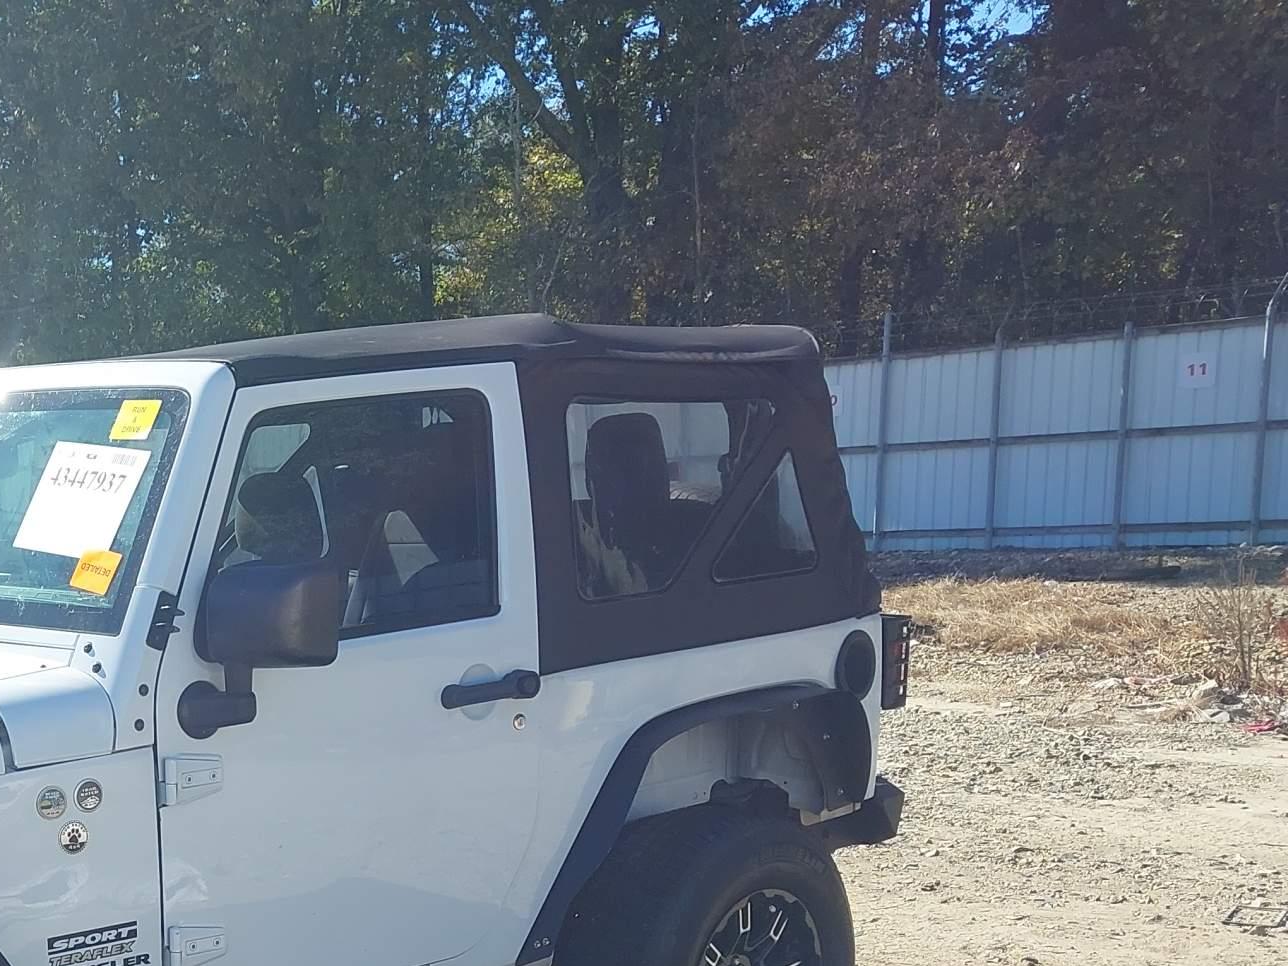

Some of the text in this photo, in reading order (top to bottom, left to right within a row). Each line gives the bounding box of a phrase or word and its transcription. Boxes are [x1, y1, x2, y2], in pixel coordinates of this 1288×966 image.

[1187, 362, 1207, 377] 11
[50, 466, 128, 494] 43447937
[80, 562, 112, 578] DETAILED
[52, 927, 131, 950] SPORT
